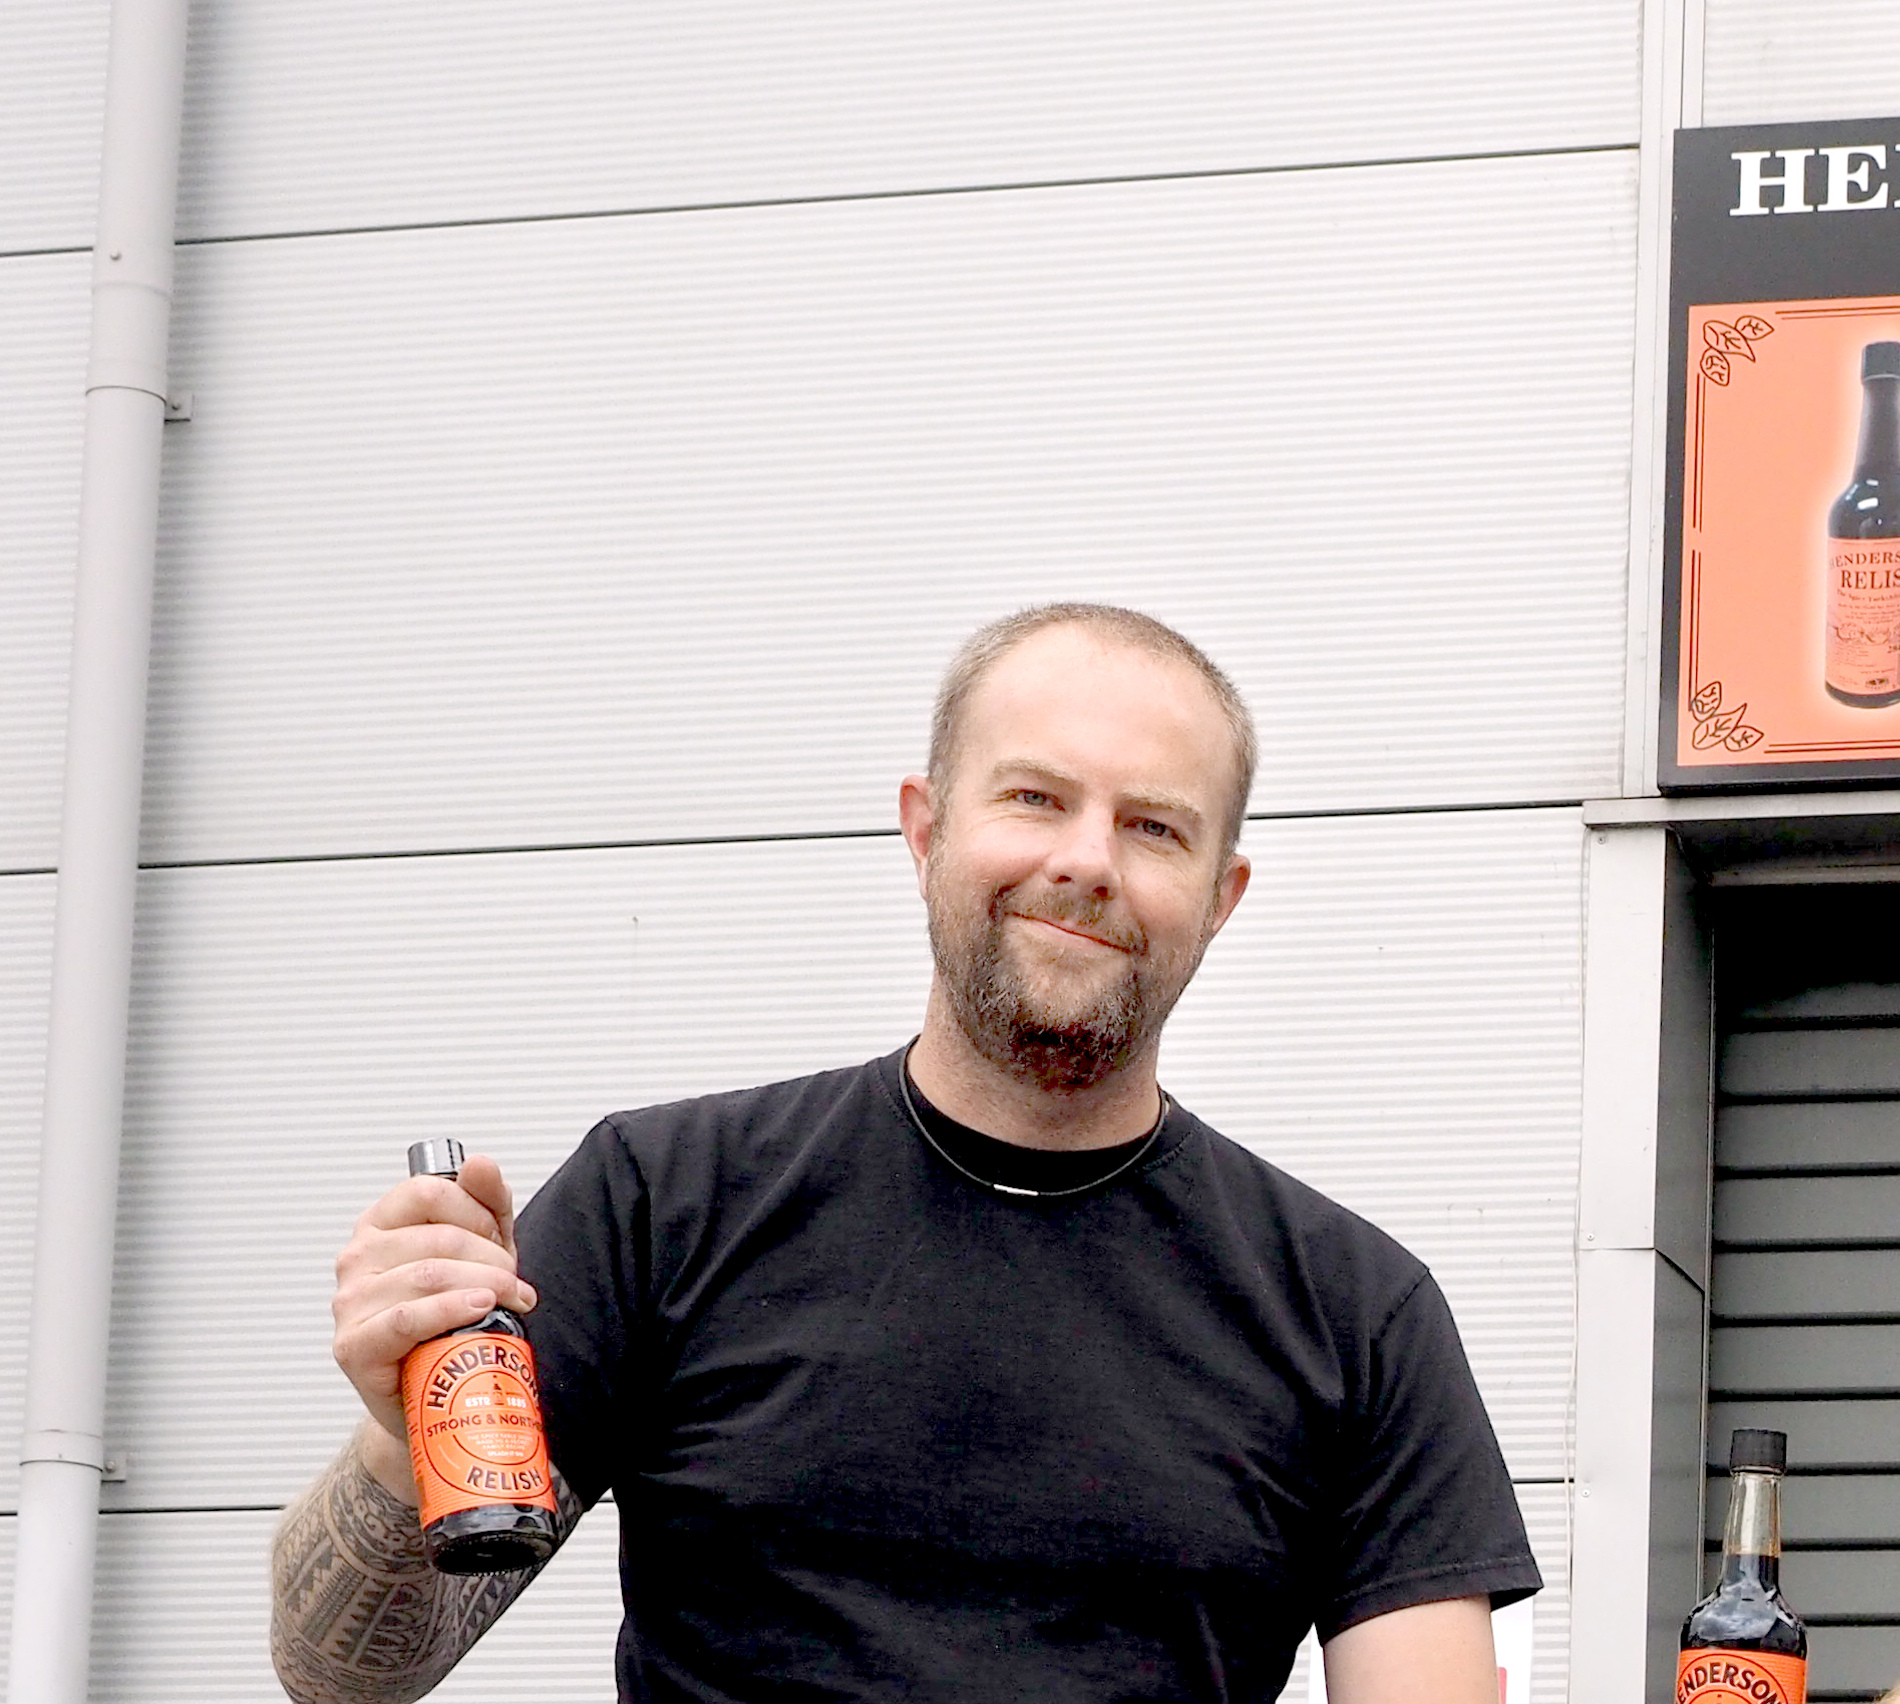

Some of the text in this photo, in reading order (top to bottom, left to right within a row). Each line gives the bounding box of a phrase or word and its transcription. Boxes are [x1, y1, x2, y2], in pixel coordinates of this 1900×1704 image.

[427, 1413, 482, 1438] STRONG
[486, 1413, 496, 1425] &
[466, 1466, 544, 1491] RELISH
